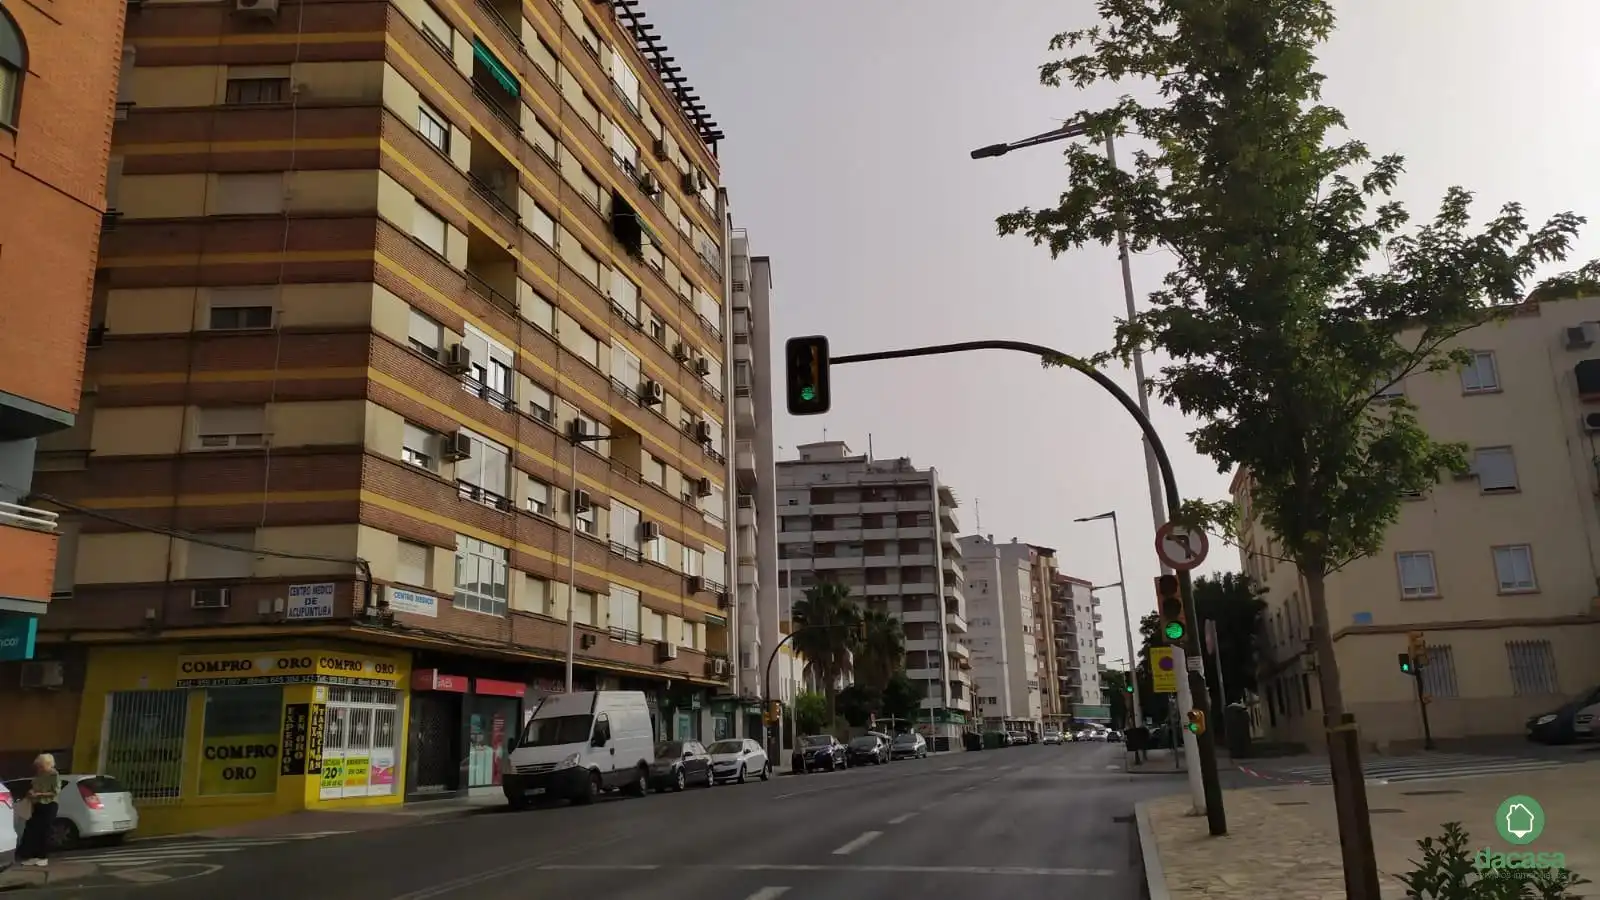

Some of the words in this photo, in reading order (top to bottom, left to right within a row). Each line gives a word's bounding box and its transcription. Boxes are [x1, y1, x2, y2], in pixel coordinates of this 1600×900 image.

[290, 586, 311, 596] CENTRO
[394, 591, 414, 602] CENTRO
[304, 597, 318, 605] DE
[289, 606, 331, 617] ACUPUNTURA
[181, 659, 252, 673] COMPRO
[277, 656, 312, 670] ORO
[319, 656, 362, 672] COMPRO
[375, 663, 395, 674] ORO
[204, 744, 278, 761] COMPRO
[222, 766, 257, 780] ORO
